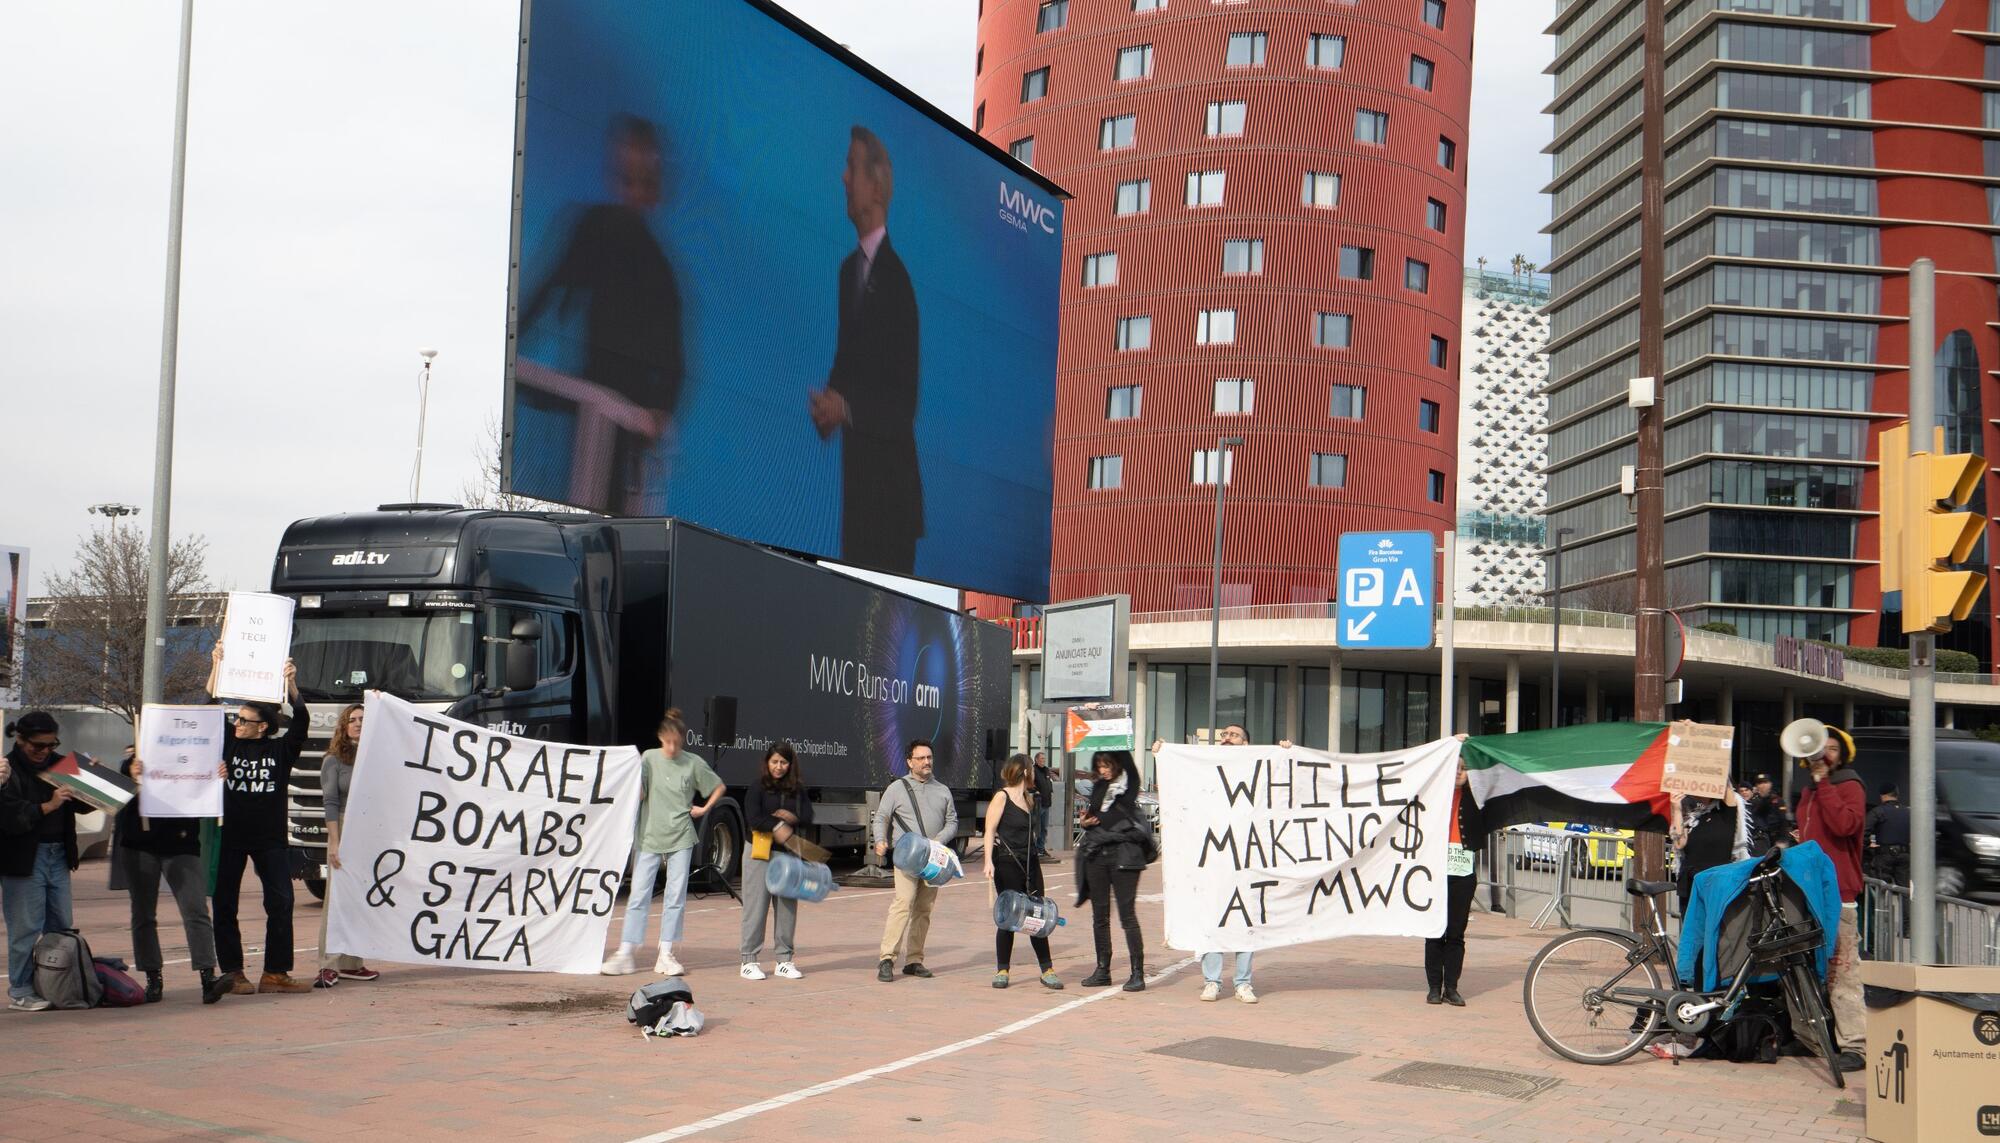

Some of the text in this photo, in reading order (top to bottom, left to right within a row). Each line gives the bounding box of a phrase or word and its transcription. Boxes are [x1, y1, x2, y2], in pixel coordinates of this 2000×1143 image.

[1000, 181, 1055, 234] MWC
[999, 209, 1028, 233] GSMA
[332, 550, 390, 566] adi.tv
[1353, 568, 1424, 605] P A
[249, 616, 264, 626] NO
[241, 632, 267, 642] TECH
[249, 651, 255, 659] 4
[810, 653, 940, 708] MWC Runs on arm
[173, 718, 198, 729] The
[487, 720, 527, 735] adi.tv
[686, 729, 705, 746] Ove
[804, 738, 827, 757] Shipped
[827, 744, 833, 755] to
[833, 743, 848, 756] Date
[177, 753, 189, 763] is
[232, 757, 276, 769] NOT IN
[404, 715, 614, 804] ISRAEL
[234, 768, 270, 780] OUR
[1217, 759, 1407, 809] WHILE
[1664, 777, 1724, 795] GENOCIDE
[410, 791, 586, 857] BOMBS
[1389, 794, 1426, 859] $
[1454, 848, 1465, 856] THE
[366, 848, 620, 917] & STARVES
[1218, 863, 1433, 928] AT MWC
[410, 910, 532, 966] GAZA
[1933, 1049, 1984, 1060] Ajuntament
[1986, 1051, 1996, 1060] de
